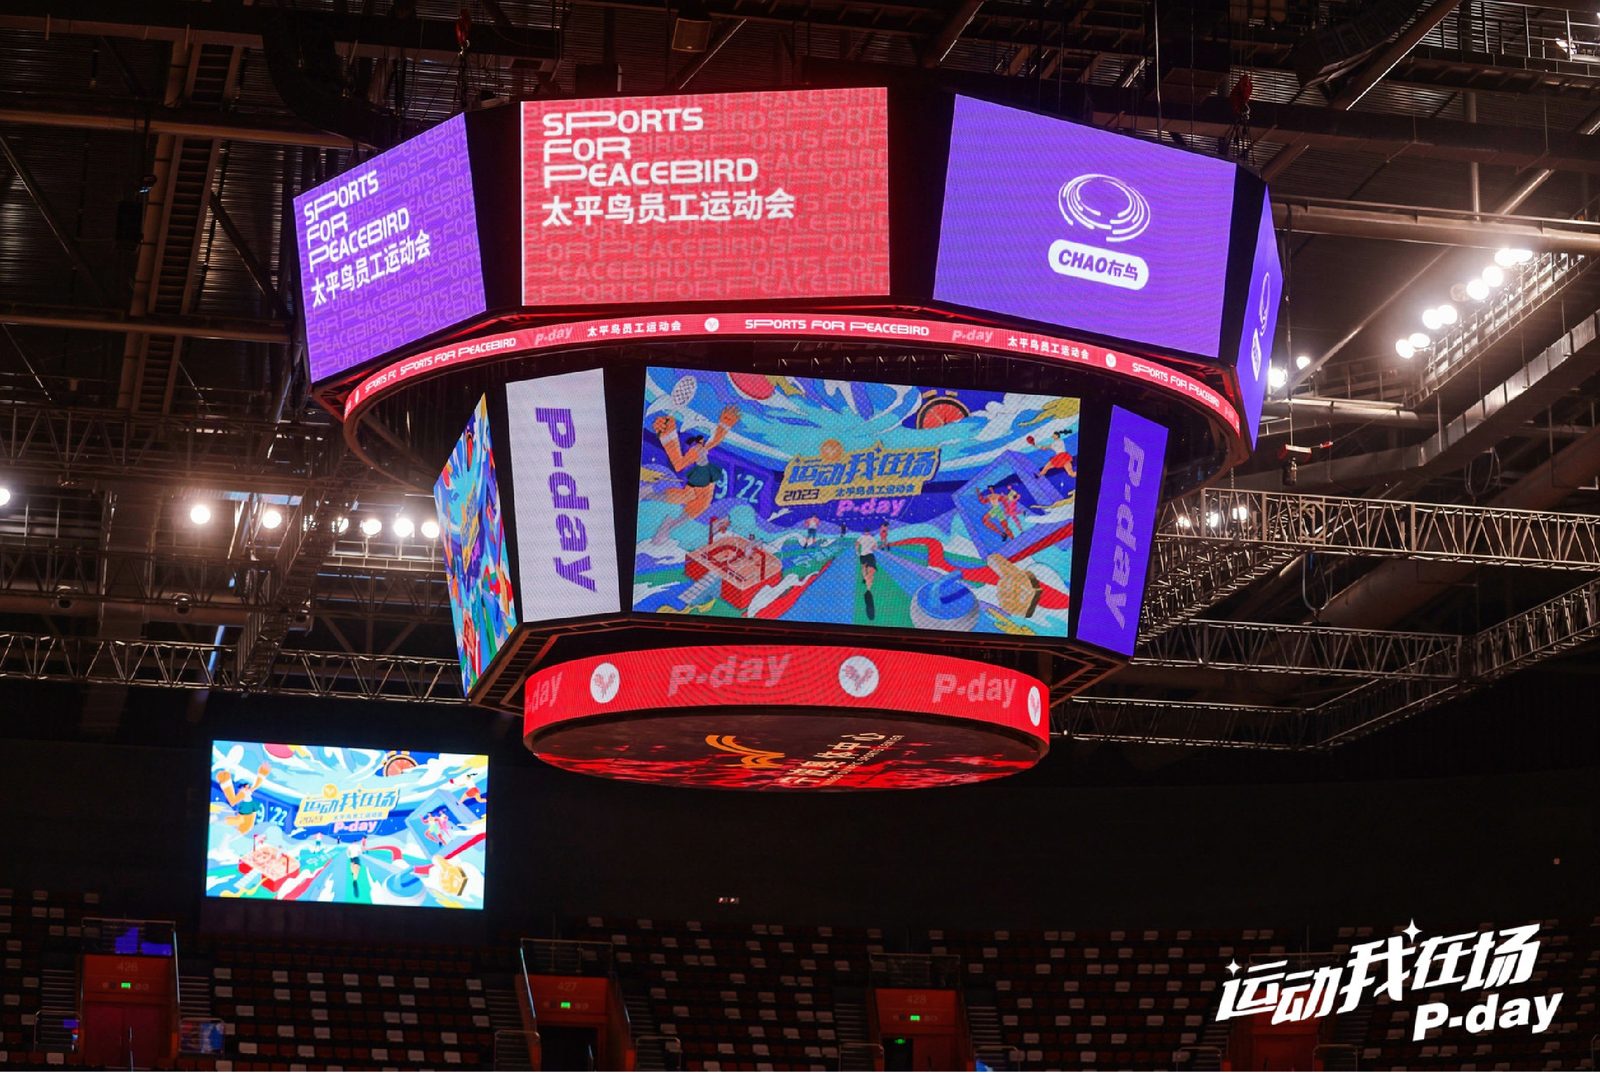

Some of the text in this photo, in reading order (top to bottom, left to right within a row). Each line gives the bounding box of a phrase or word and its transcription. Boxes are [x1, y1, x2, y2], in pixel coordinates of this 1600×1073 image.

[542, 107, 704, 136] SPORTS
[543, 137, 631, 163] FOR
[543, 157, 759, 189] PEACEBIRD
[304, 169, 379, 226] SPORTS
[541, 187, 795, 227] 太平鸟员工运动会
[306, 211, 349, 249] FOR
[308, 207, 410, 273] PEACEBIRD
[311, 229, 431, 308] 太平鸟员工运动会
[587, 320, 682, 337] 太平鸟员工运动会
[745, 319, 930, 336] SPORTS FOR PEACEBIRD
[400, 337, 516, 376] SPORTS FOR PEACEBIRD
[1007, 335, 1089, 360] 太平鸟员工运动会
[1132, 362, 1169, 382] SPORTS
[788, 450, 936, 487] 运动我在场
[535, 406, 598, 593] P-day
[783, 488, 820, 501] 2023
[1104, 436, 1145, 631] P-day
